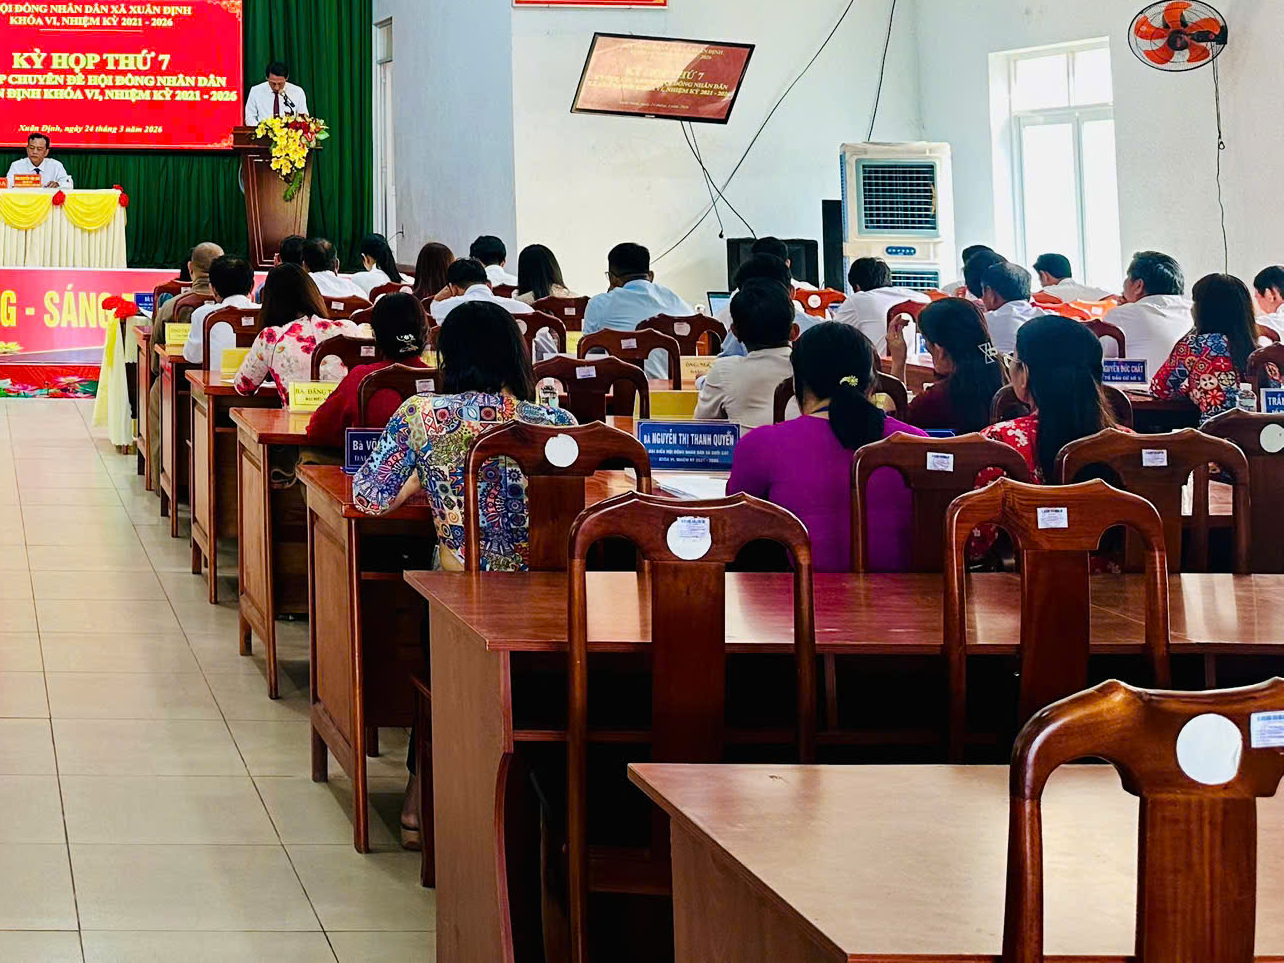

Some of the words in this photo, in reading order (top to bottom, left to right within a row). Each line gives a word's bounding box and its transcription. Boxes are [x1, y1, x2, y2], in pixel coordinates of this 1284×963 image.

[14, 3, 48, 17] ĐỒNG
[50, 3, 83, 14] NHÂN
[84, 3, 109, 17] DÂN
[110, 4, 127, 17] XÃ
[129, 4, 161, 15] XUÂN
[162, 5, 192, 17] ĐỊNH
[9, 15, 44, 25] KHÓA
[44, 16, 60, 26] VI,
[61, 16, 100, 28] NHIỆM
[102, 16, 119, 26] KỲ
[121, 17, 143, 26] 2021
[151, 17, 173, 27] 2026
[12, 48, 47, 69] KỲ
[50, 52, 100, 74] HỌP
[102, 49, 156, 70] THỨ
[158, 54, 171, 71] 7
[7, 72, 65, 85] CHUYÊN
[66, 72, 86, 88] ĐỀ
[87, 73, 114, 88] HỘI
[114, 73, 156, 87] ĐỒNG
[156, 73, 196, 89] NHÂN
[197, 74, 227, 87] DÂN
[6, 88, 42, 101] ĐỊNH
[43, 87, 84, 100] KHÓA
[84, 88, 103, 101] VI,
[104, 88, 151, 102] NHIỆM
[152, 87, 174, 101] KỲ
[174, 90, 201, 101] 2021
[210, 90, 238, 101] 2026
[678, 433, 689, 447] THỊ
[690, 433, 712, 445] THANH
